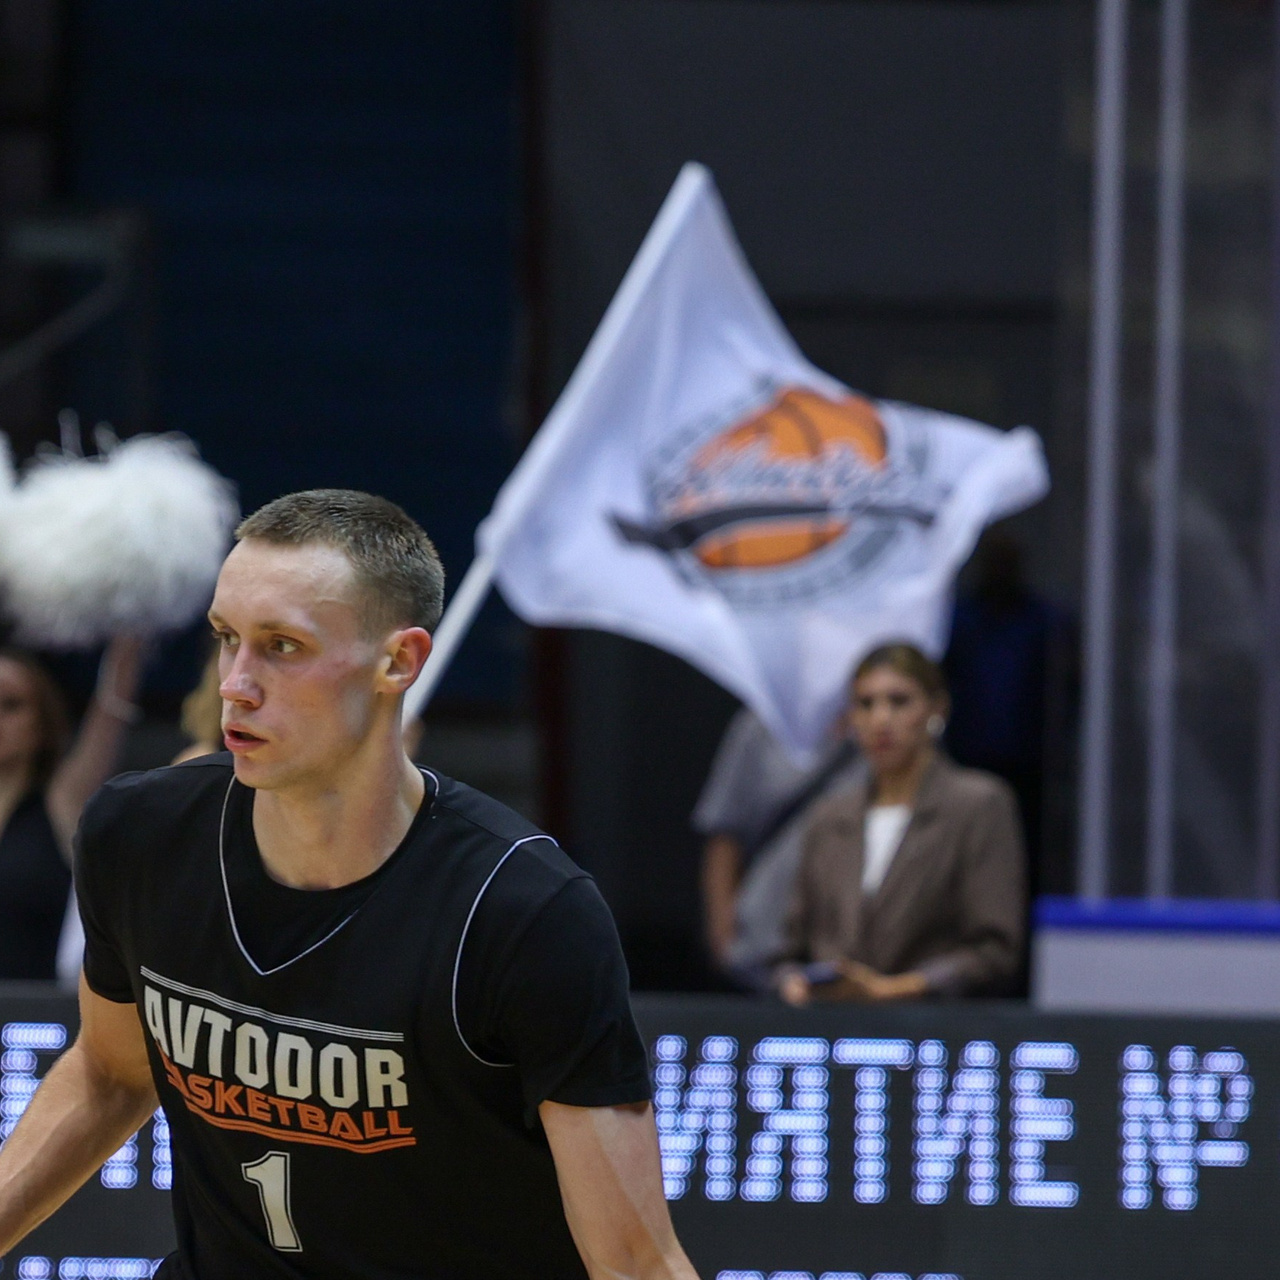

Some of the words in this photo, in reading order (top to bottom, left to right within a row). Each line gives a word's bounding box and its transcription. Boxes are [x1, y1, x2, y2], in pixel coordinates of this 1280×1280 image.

[144, 984, 410, 1109] AVTODOR
[157, 1040, 414, 1141] ASKETBALL
[650, 1034, 1081, 1207] ИЯТИЕ
[241, 1150, 303, 1252] 1
